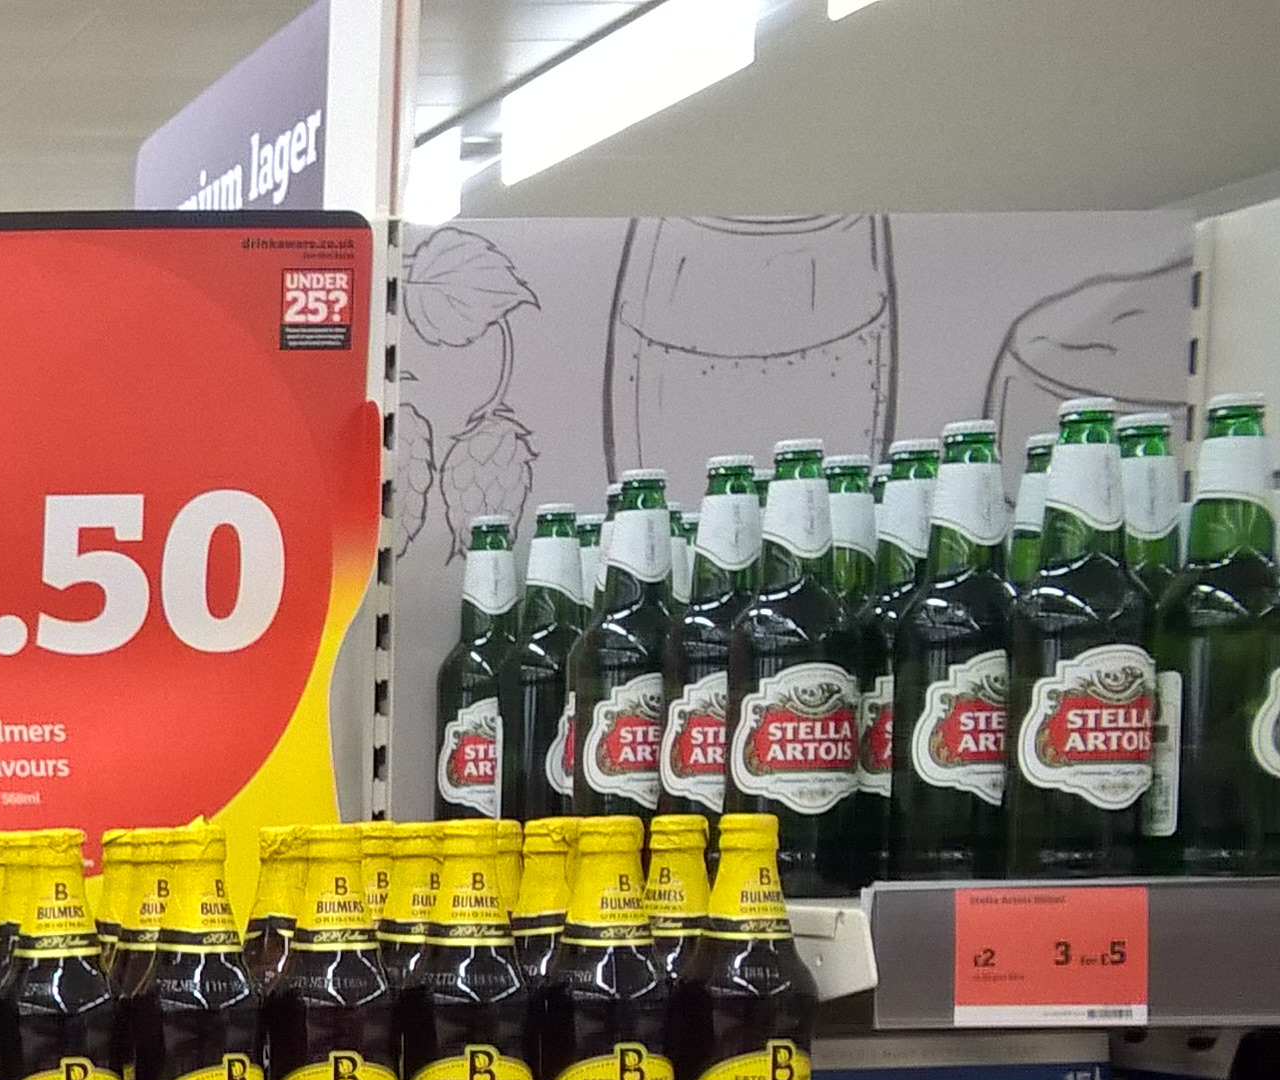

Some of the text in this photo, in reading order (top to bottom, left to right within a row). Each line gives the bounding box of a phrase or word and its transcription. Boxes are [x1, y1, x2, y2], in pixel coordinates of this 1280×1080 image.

[249, 110, 321, 205] lager
[286, 273, 348, 289] UNDER
[284, 291, 348, 322] 25?
[1067, 709, 1152, 728] STELLA
[768, 720, 851, 741] STELLA
[1065, 731, 1151, 751] ARTOIS
[766, 741, 852, 762] ARTOIS
[973, 949, 996, 968] £2
[1054, 940, 1072, 966] 3
[1100, 940, 1127, 966] £5
